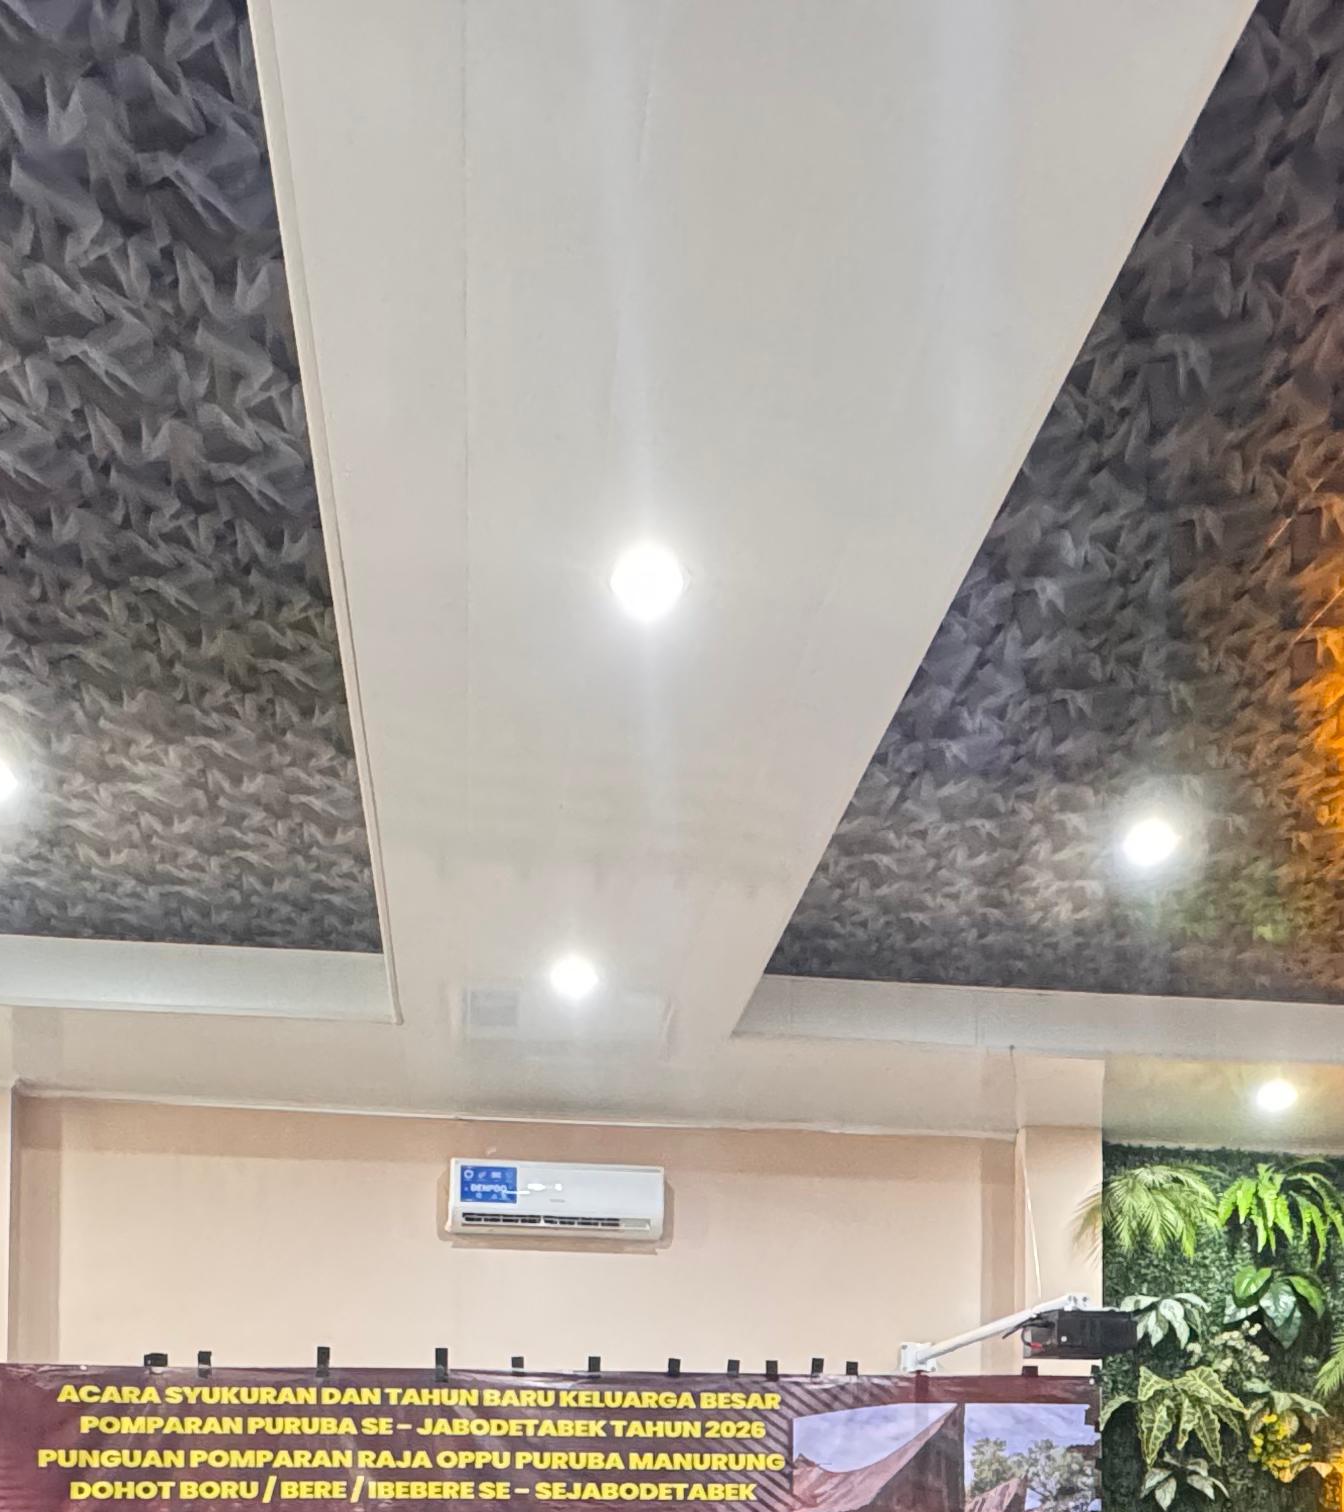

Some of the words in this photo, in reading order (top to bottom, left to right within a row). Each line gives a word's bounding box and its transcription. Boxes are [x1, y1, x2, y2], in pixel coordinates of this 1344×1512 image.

[57, 1384, 162, 1404] ACARA
[164, 1385, 317, 1405] SYUKURAN
[321, 1387, 381, 1405] DAN
[384, 1387, 478, 1406] TAHUN
[483, 1389, 558, 1407] BARU
[560, 1391, 696, 1409] KELUARGA
[700, 1392, 781, 1410] BESAR
[80, 1415, 243, 1435] POMPARAN
[247, 1417, 357, 1436] PURUBA
[361, 1417, 393, 1436] SE
[416, 1418, 606, 1437] JABODETABEK
[610, 1420, 701, 1438] TAHUN
[704, 1421, 766, 1439] 2026
[38, 1448, 185, 1468] PUNGUAN
[189, 1449, 353, 1468] POMPARAN
[357, 1450, 432, 1469] RAJA
[436, 1450, 510, 1469] OPPU
[515, 1451, 624, 1470] PURUBA
[628, 1451, 785, 1471] MANURUNG
[70, 1480, 175, 1500] DOHOT
[179, 1480, 259, 1500] BORU
[280, 1480, 346, 1500] BERE
[368, 1480, 474, 1500] IBEBERE
[479, 1482, 510, 1500] SE
[535, 1481, 758, 1501] SEJABODETABEK
